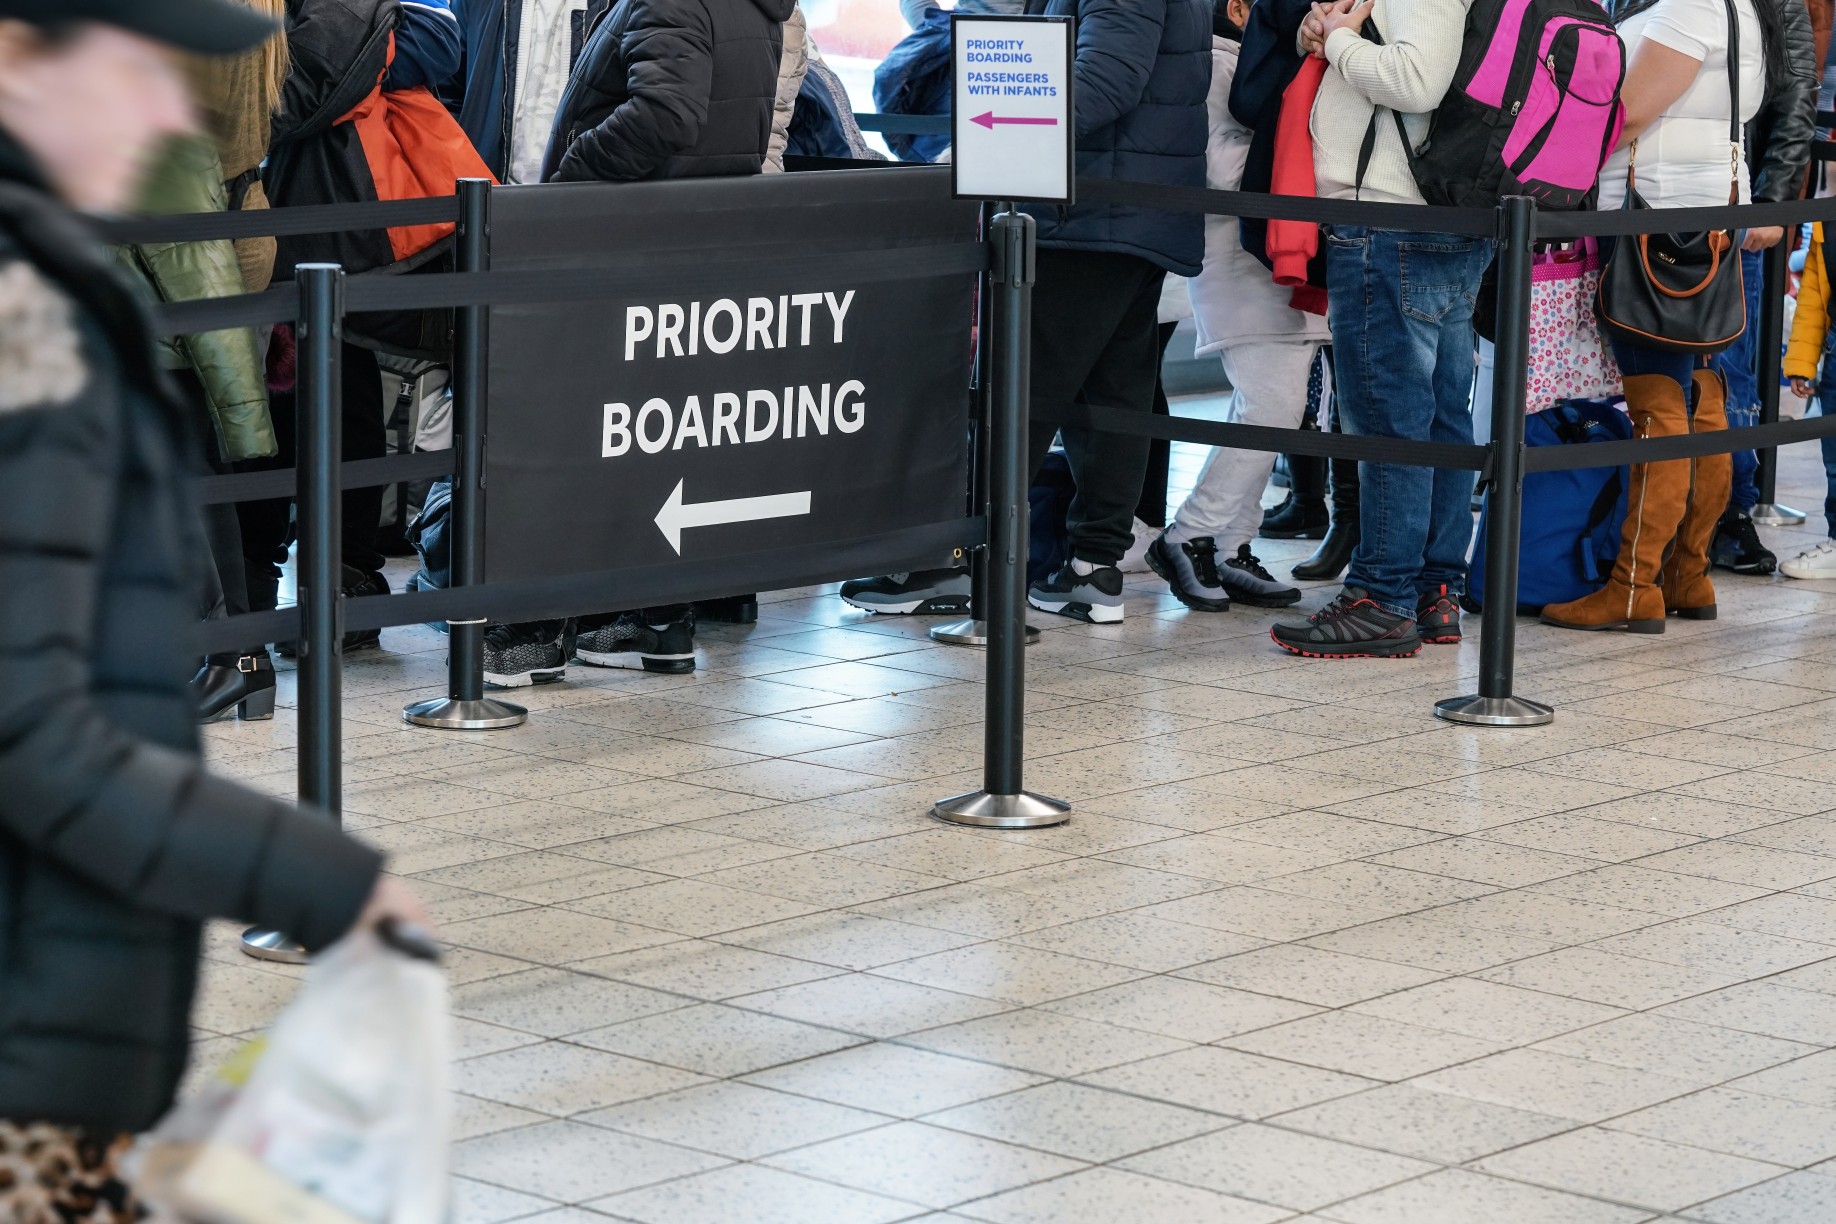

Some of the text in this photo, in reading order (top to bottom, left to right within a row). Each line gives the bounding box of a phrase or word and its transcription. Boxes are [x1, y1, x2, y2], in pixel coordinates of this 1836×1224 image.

[966, 39, 1024, 50] PRIORITY
[966, 52, 1033, 63] BOARDING
[967, 72, 1049, 83] PASSENGERS
[968, 85, 1057, 97] WITH INFANTS
[624, 290, 856, 361] PRIORITY
[601, 379, 866, 458] BOARDING
